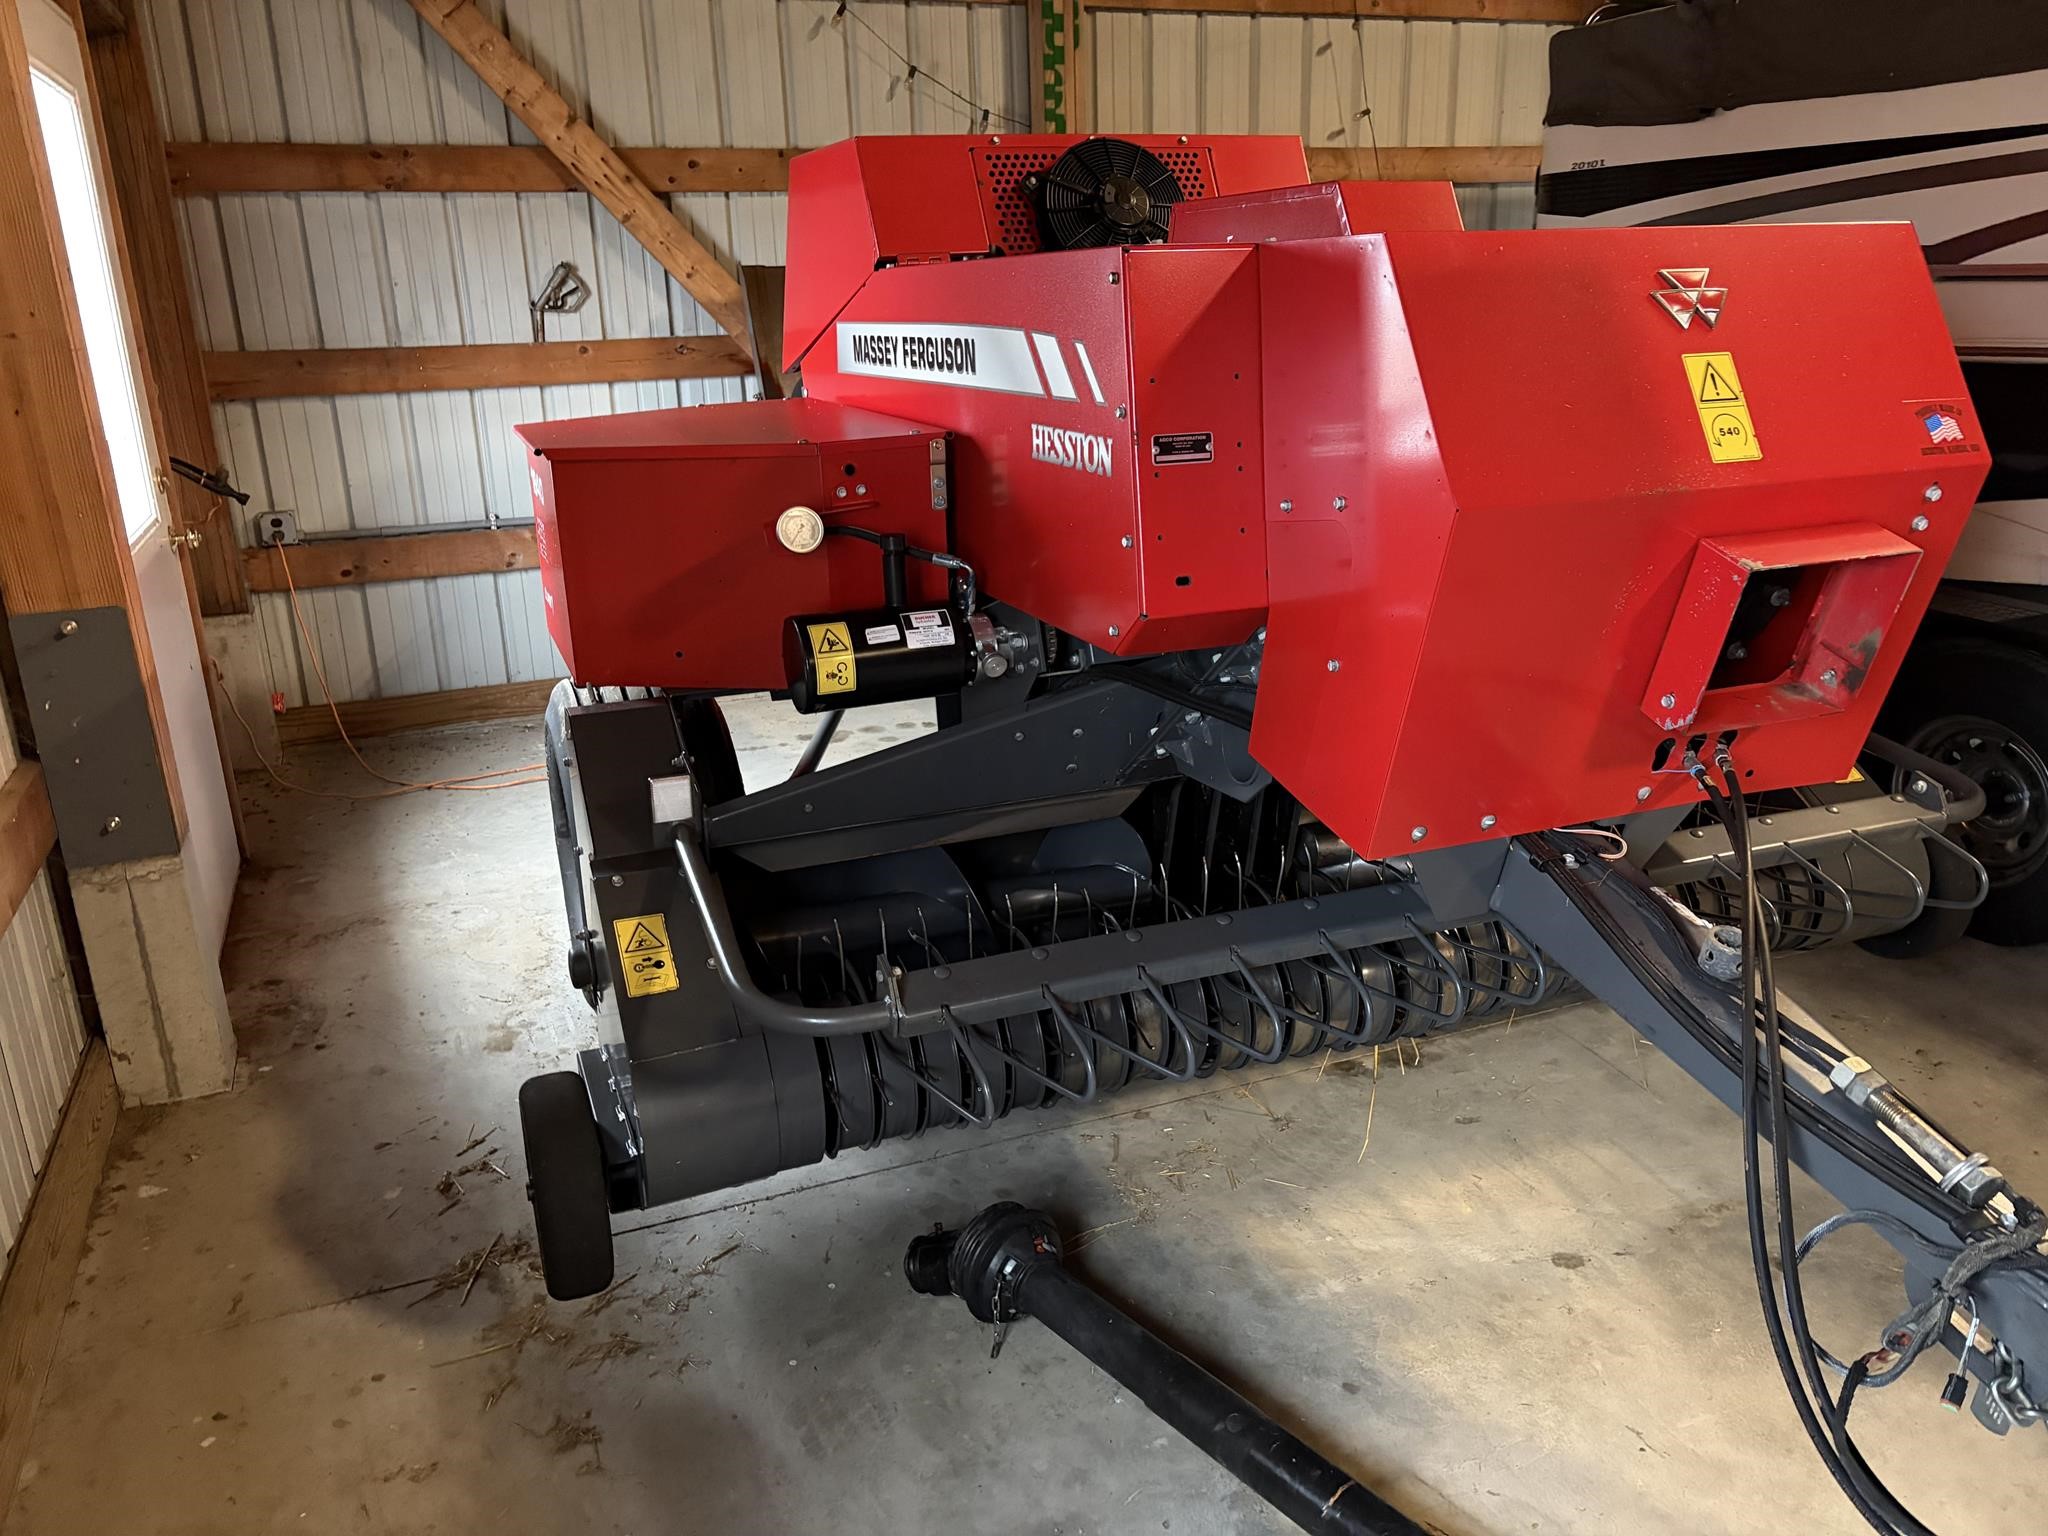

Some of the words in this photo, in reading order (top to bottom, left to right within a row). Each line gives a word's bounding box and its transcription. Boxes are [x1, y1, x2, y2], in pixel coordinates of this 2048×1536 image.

[852, 334, 899, 368] MASSEY
[902, 336, 977, 375] FERGUSON
[1031, 424, 1113, 477] HESSTON
[1718, 426, 1741, 437] 540
